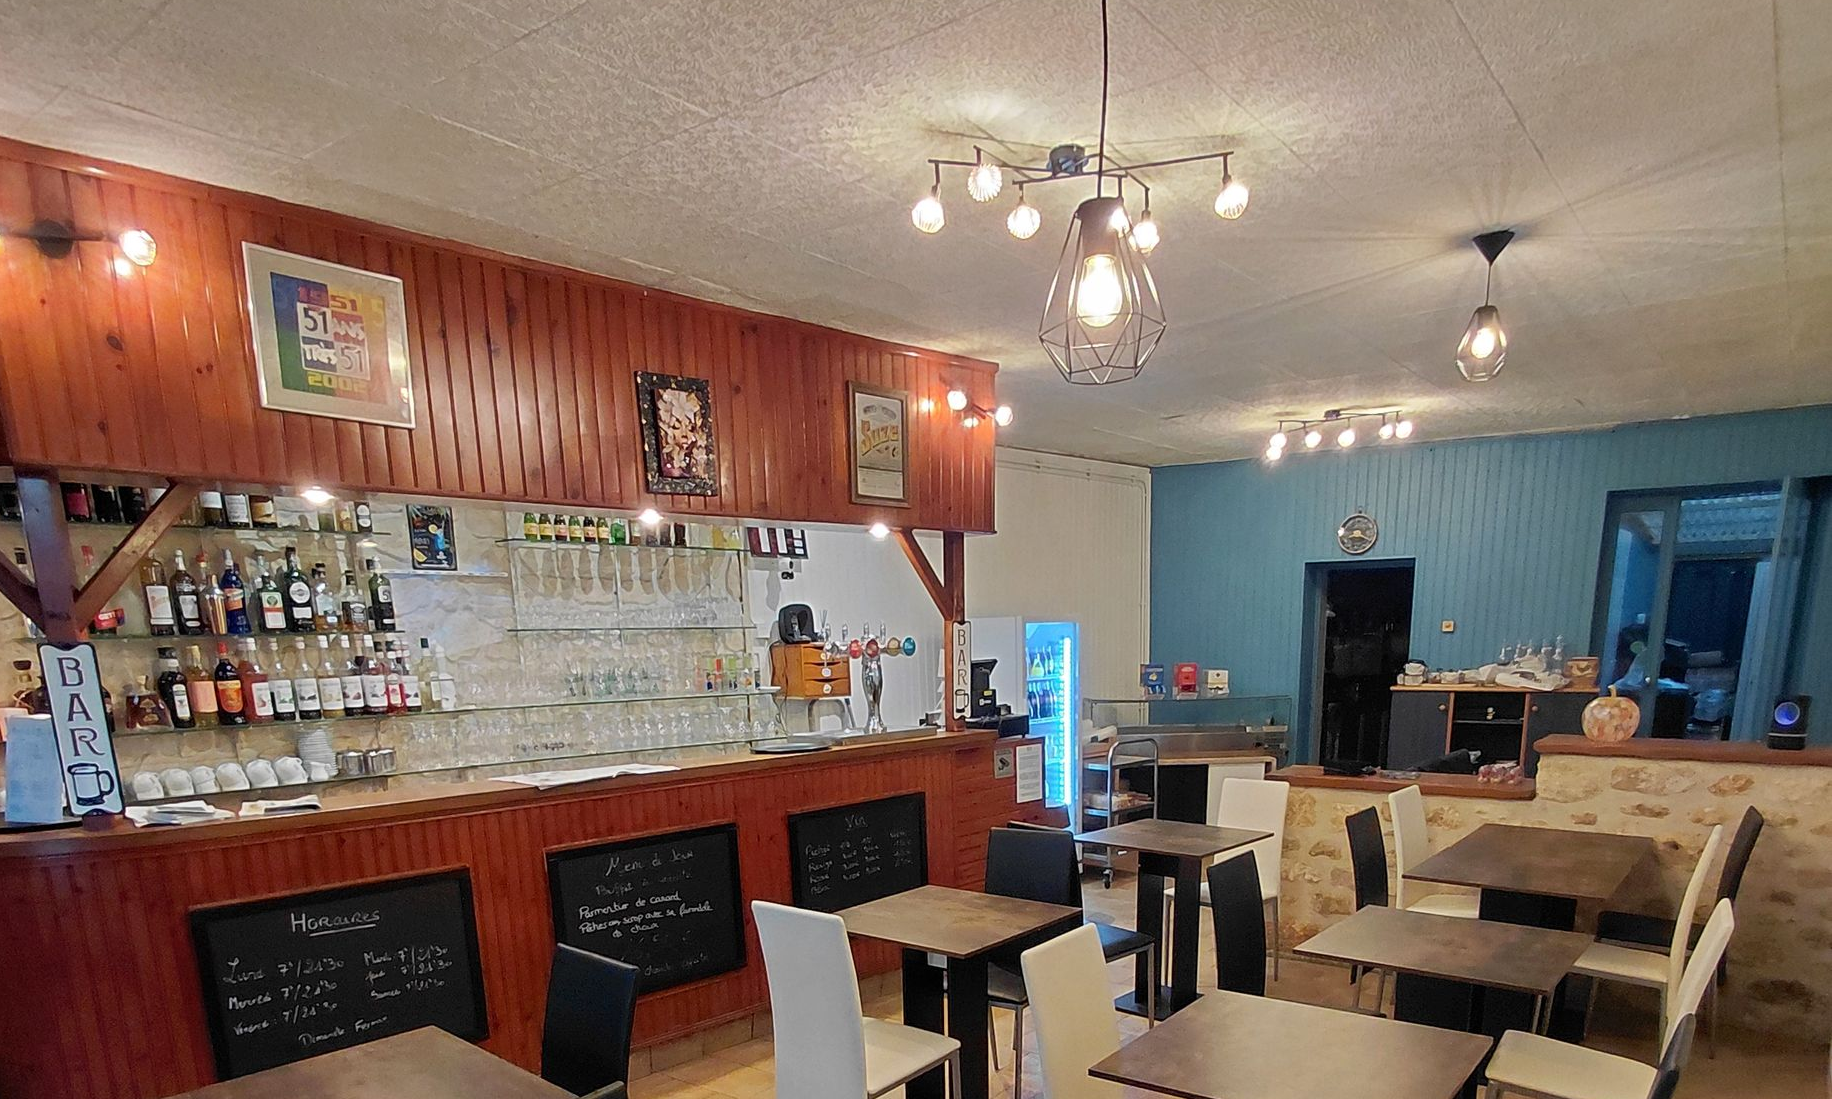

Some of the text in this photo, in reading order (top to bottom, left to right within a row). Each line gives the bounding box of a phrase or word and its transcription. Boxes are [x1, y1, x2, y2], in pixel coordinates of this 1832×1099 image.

[303, 307, 328, 335] 51
[341, 346, 364, 372] 51
[861, 419, 899, 450] Suze
[957, 628, 969, 686] BAR
[57, 656, 105, 757] BAR
[635, 897, 646, 908] de
[649, 891, 682, 905] canard
